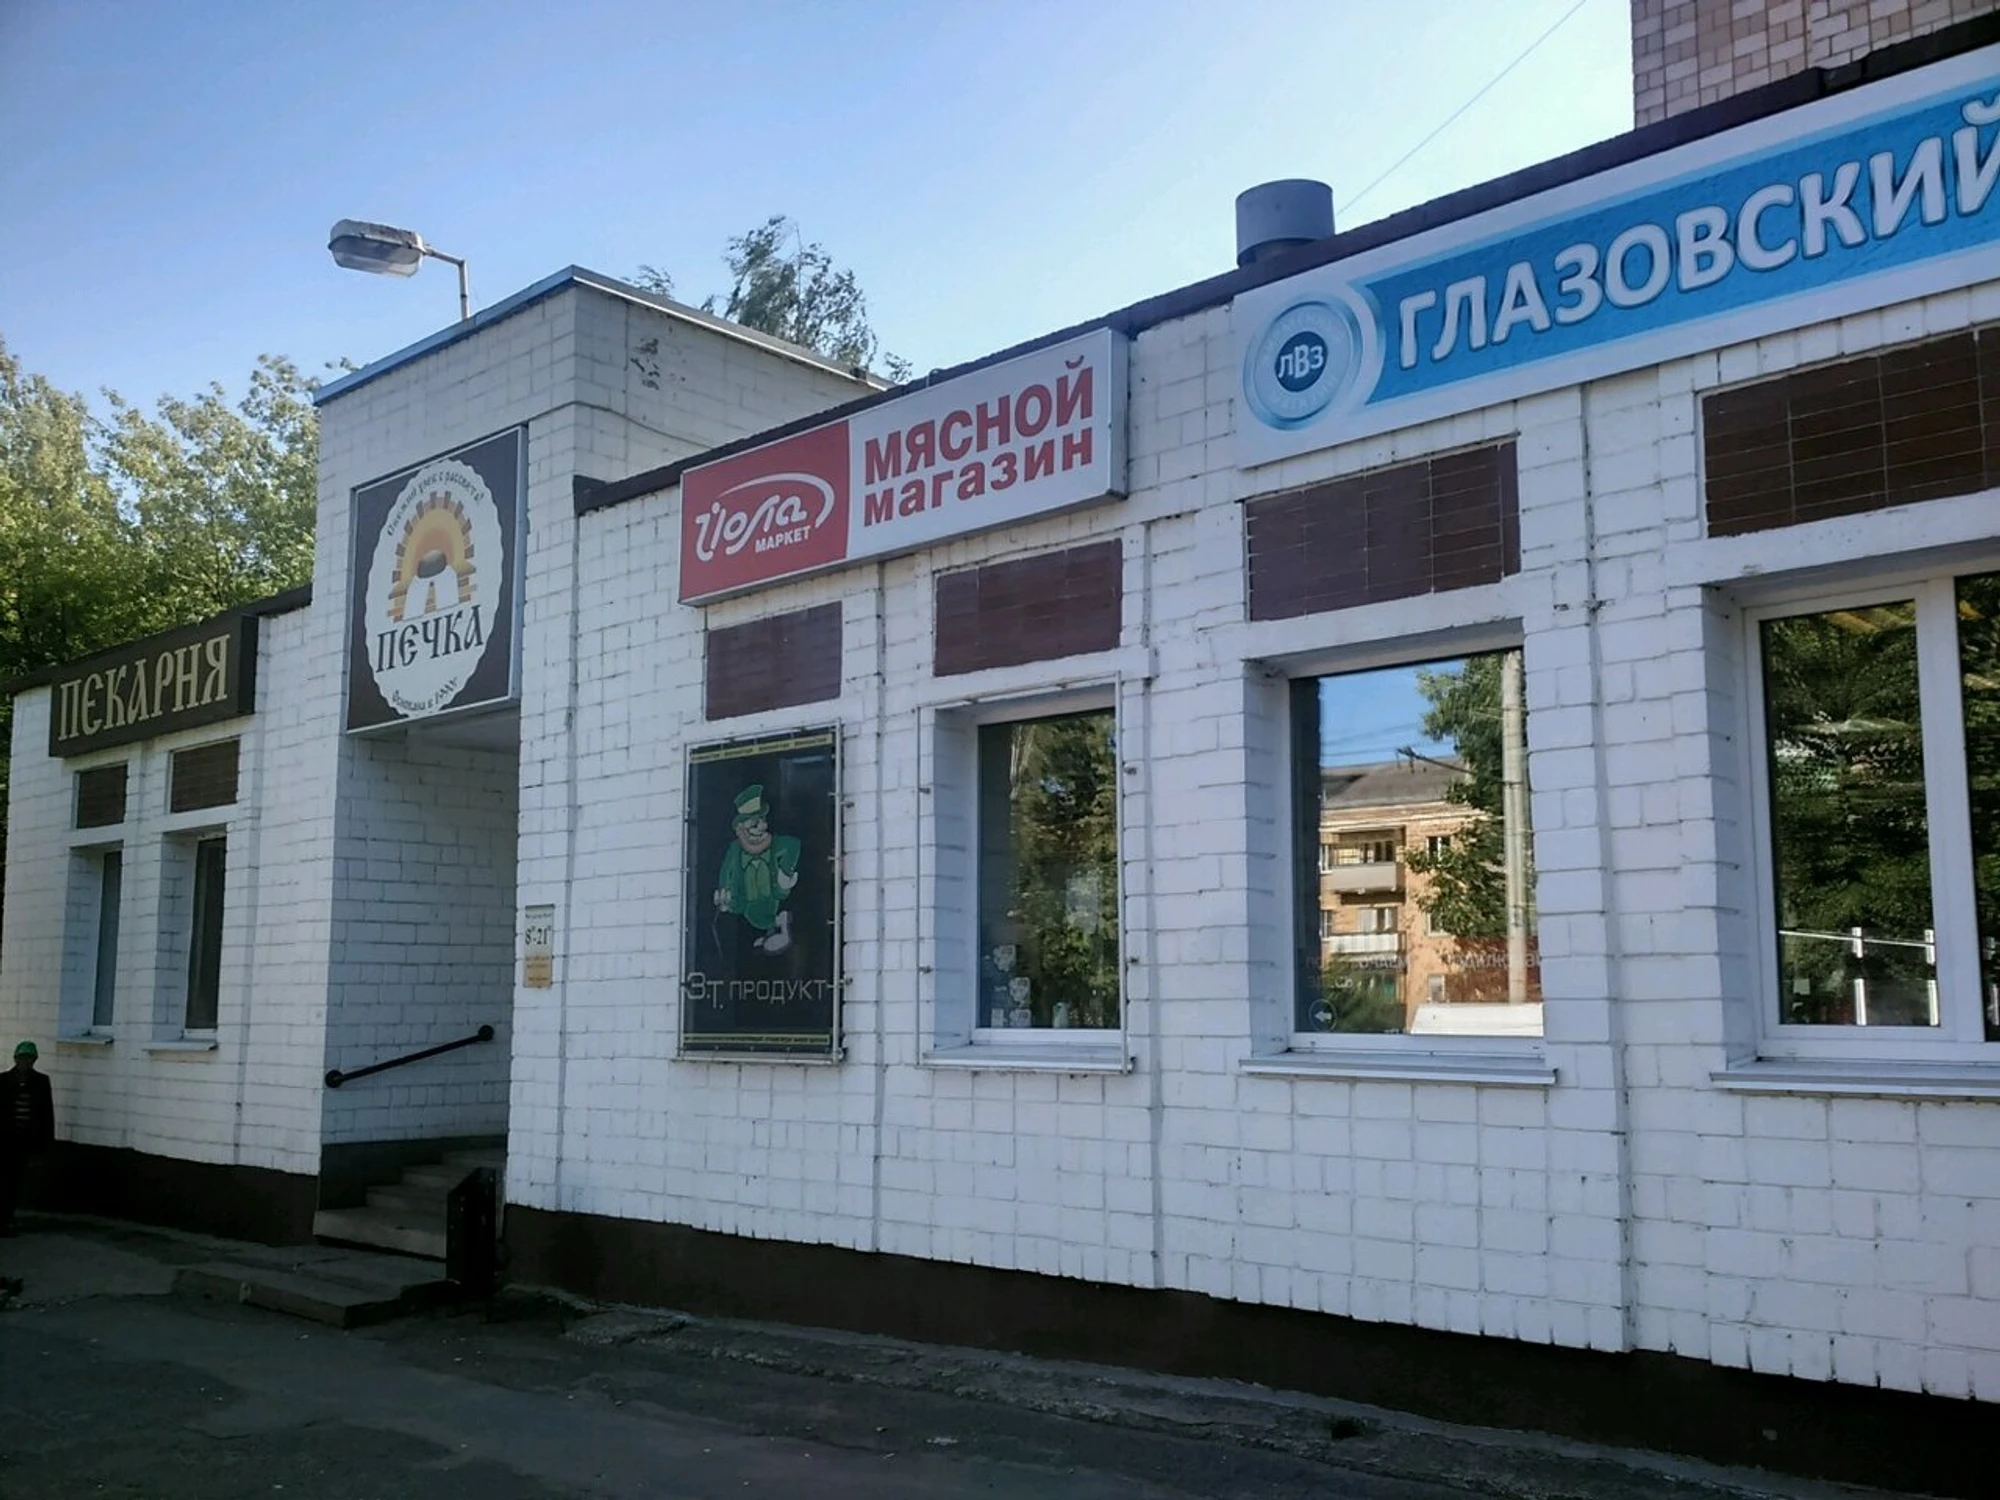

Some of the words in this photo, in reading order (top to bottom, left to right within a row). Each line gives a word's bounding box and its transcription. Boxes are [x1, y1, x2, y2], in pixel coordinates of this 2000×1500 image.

[1398, 96, 2000, 369] ГЛАЗОВСКИЙ
[864, 354, 1094, 486] МЯСНОЙ
[863, 426, 1093, 527] магазин
[755, 525, 812, 554] МАРКЕТ
[58, 634, 231, 742] ПЕКАРНЯ
[375, 604, 486, 673] ПЕЧКА
[729, 980, 828, 1005] ПРОДУКТ
